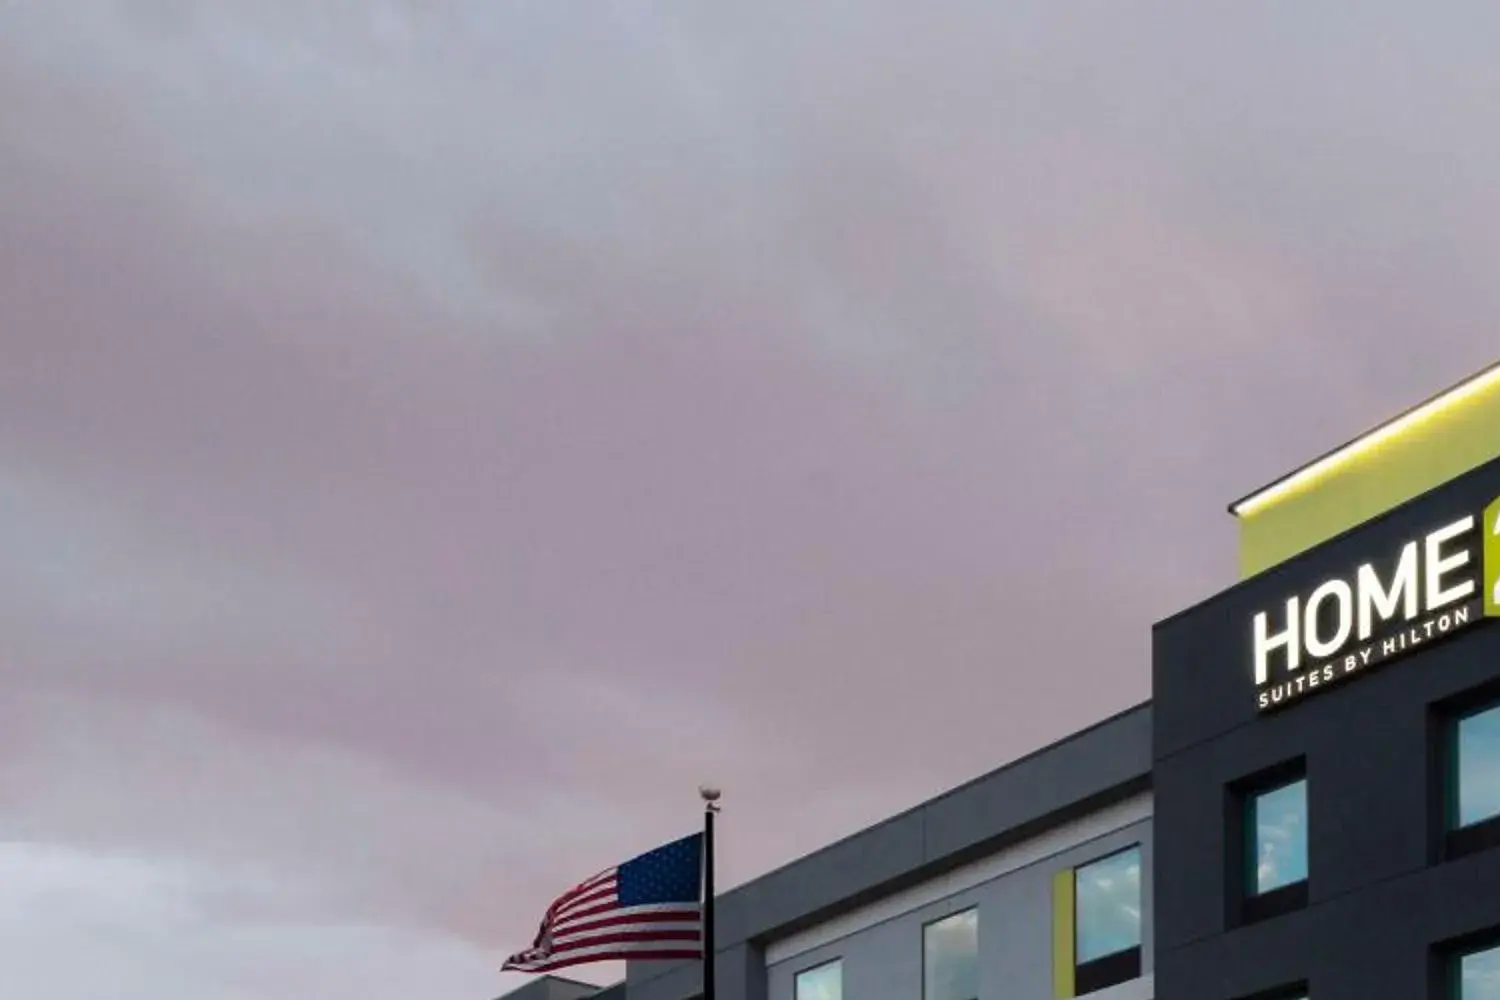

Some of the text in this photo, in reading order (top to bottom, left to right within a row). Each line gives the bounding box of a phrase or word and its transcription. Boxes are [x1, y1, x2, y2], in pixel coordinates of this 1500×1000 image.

[1254, 515, 1475, 685] HOME
[1259, 606, 1470, 709] SUITES BY HILTON
